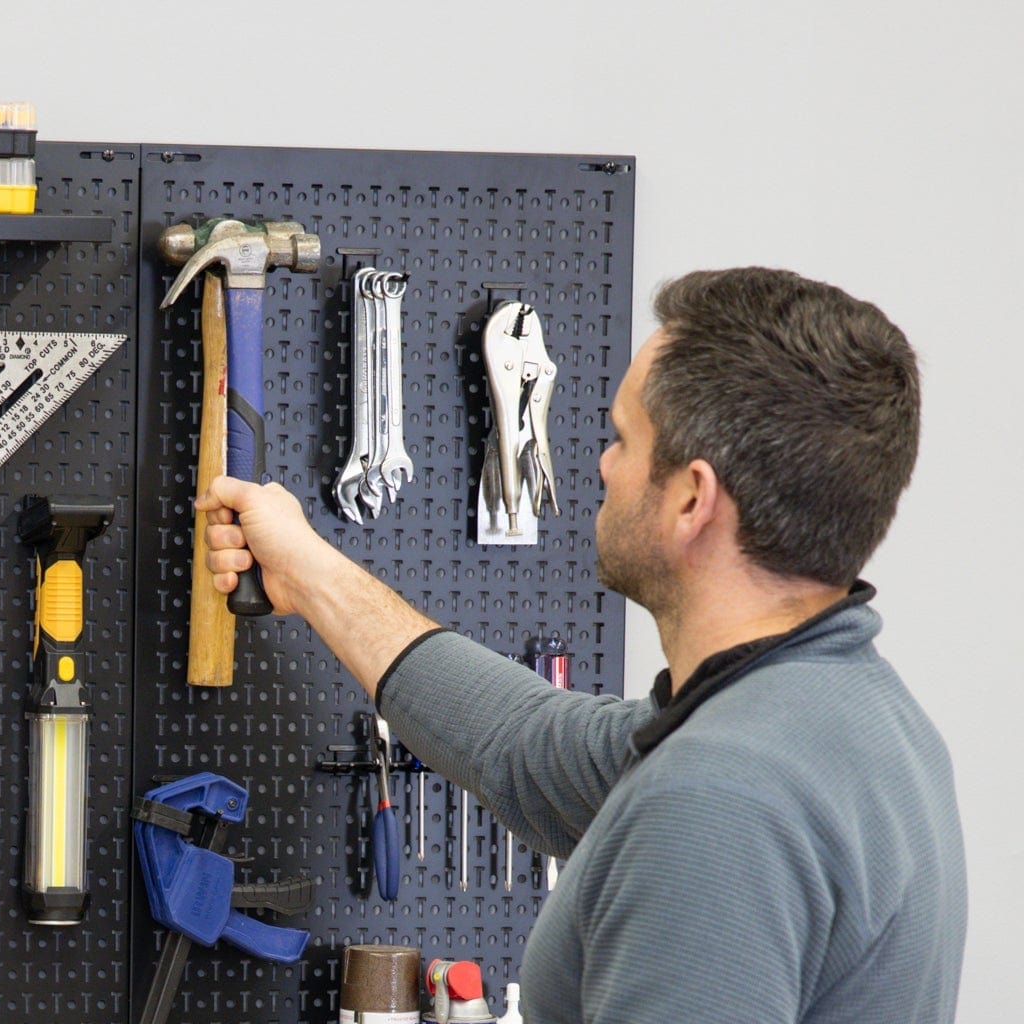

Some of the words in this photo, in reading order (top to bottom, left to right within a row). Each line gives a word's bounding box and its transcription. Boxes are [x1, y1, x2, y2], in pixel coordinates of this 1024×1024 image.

[24, 359, 37, 373] TOP
[39, 340, 58, 358] CUTS
[50, 347, 78, 375] COMMON
[0, 440, 7, 449] 40
[8, 430, 17, 440] 45
[16, 422, 25, 431] 50
[26, 412, 35, 422] 55
[35, 403, 44, 412] 60
[45, 393, 54, 402] 65
[55, 382, 64, 392] 70
[66, 370, 76, 380] 75
[79, 358, 89, 368] 80
[89, 342, 106, 358] DEG.
[1, 380, 11, 390] 30
[1, 424, 10, 432] 12
[12, 413, 20, 421] 15
[20, 405, 28, 413] 18
[31, 393, 40, 402] 24
[40, 384, 49, 393] 30
